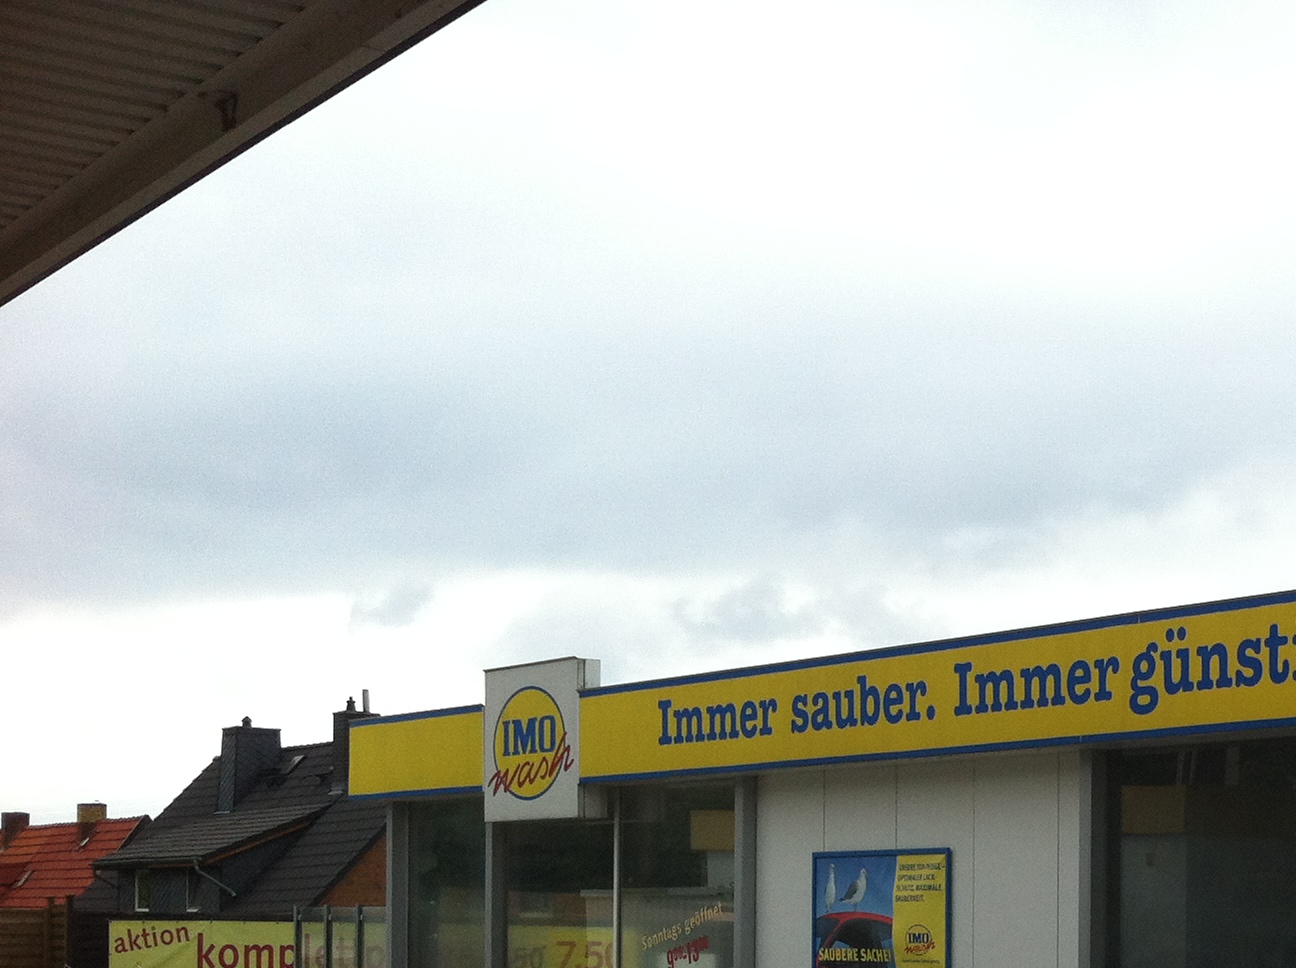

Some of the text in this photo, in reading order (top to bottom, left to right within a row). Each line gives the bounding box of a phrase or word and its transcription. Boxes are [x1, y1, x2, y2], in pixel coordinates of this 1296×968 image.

[660, 699, 778, 745] Immer
[791, 675, 936, 733] sauber.
[954, 656, 1121, 716] Immer
[502, 715, 557, 757] IMO
[488, 731, 575, 797] wash
[114, 926, 190, 954] aktion
[641, 900, 724, 952] Sonntags geöffnet
[818, 947, 859, 962] SAUBERE
